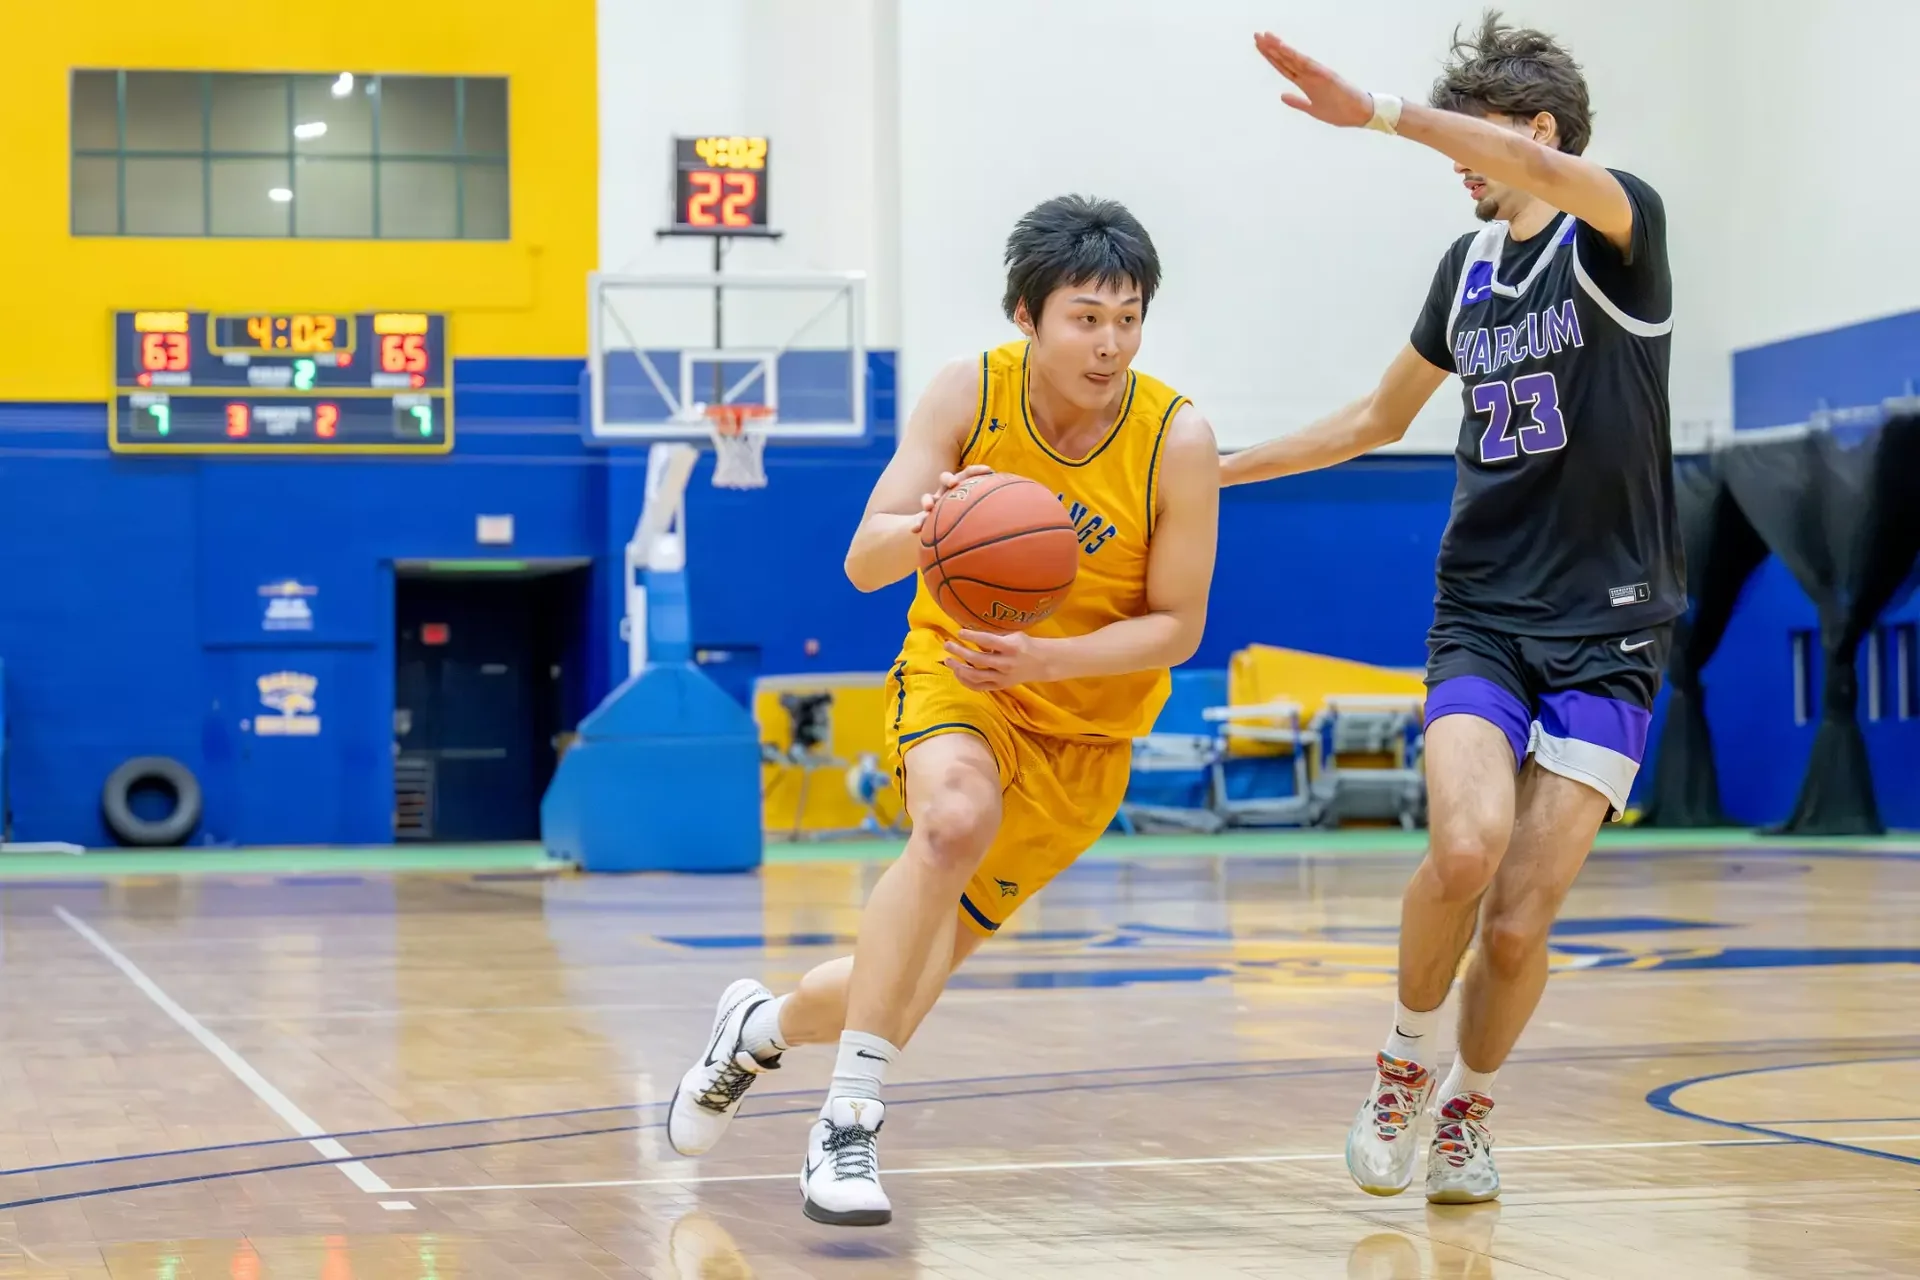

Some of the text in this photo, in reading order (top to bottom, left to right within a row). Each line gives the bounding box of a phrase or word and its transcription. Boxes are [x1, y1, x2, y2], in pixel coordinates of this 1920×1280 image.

[695, 136, 767, 168] 4:02
[687, 171, 757, 226] 22
[142, 332, 190, 371] 63
[247, 314, 337, 352] 4:02
[1455, 299, 1584, 377] HARCUM
[381, 334, 428, 373] 65
[294, 359, 316, 389] 2
[315, 404, 339, 437] 2
[1472, 371, 1568, 463] 23
[1057, 490, 1117, 556] NGS
